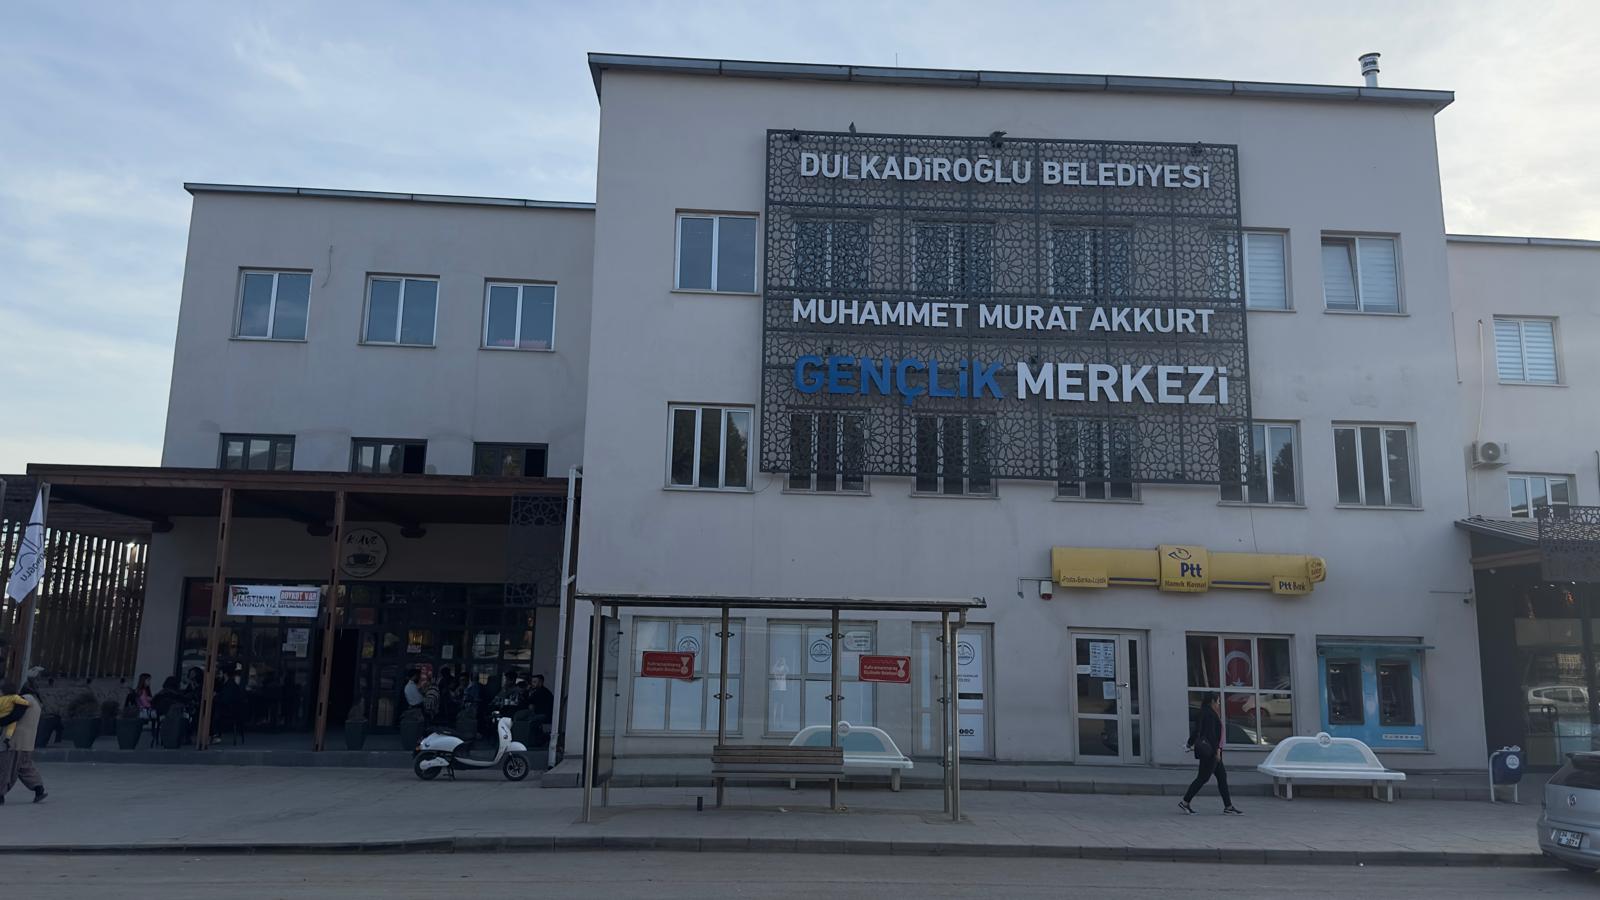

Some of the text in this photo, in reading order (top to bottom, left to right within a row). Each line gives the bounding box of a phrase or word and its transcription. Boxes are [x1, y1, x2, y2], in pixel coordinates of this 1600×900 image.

[1042, 161, 1211, 189] BELEDİYESİ
[792, 297, 1215, 334] MUHAMMET MURAT AKKURT
[793, 354, 1229, 407] GENÇLİK MERKEZİ
[1180, 562, 1203, 578] Ptt
